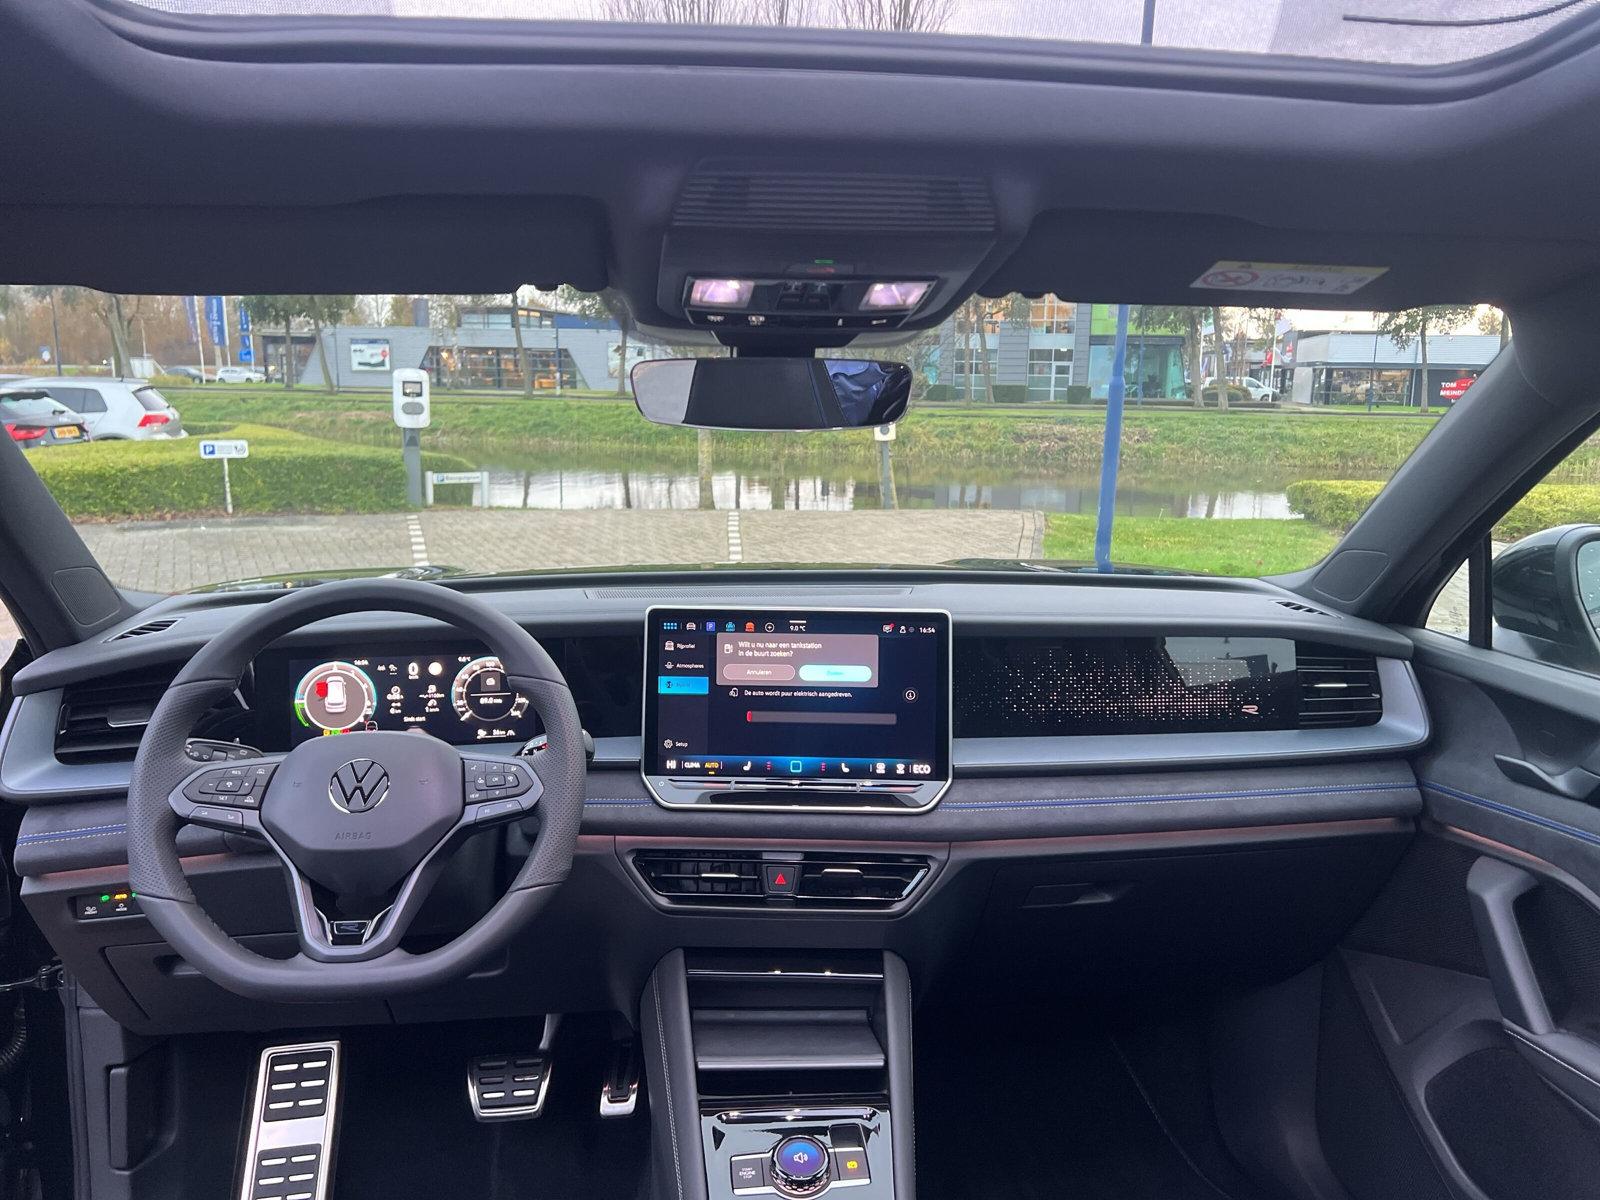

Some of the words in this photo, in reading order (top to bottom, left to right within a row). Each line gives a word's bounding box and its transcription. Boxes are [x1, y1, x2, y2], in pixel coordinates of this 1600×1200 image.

[738, 641, 751, 649] Wilt
[666, 760, 677, 769] HI
[912, 764, 931, 774] ECO
[335, 832, 372, 840] AIRBAG
